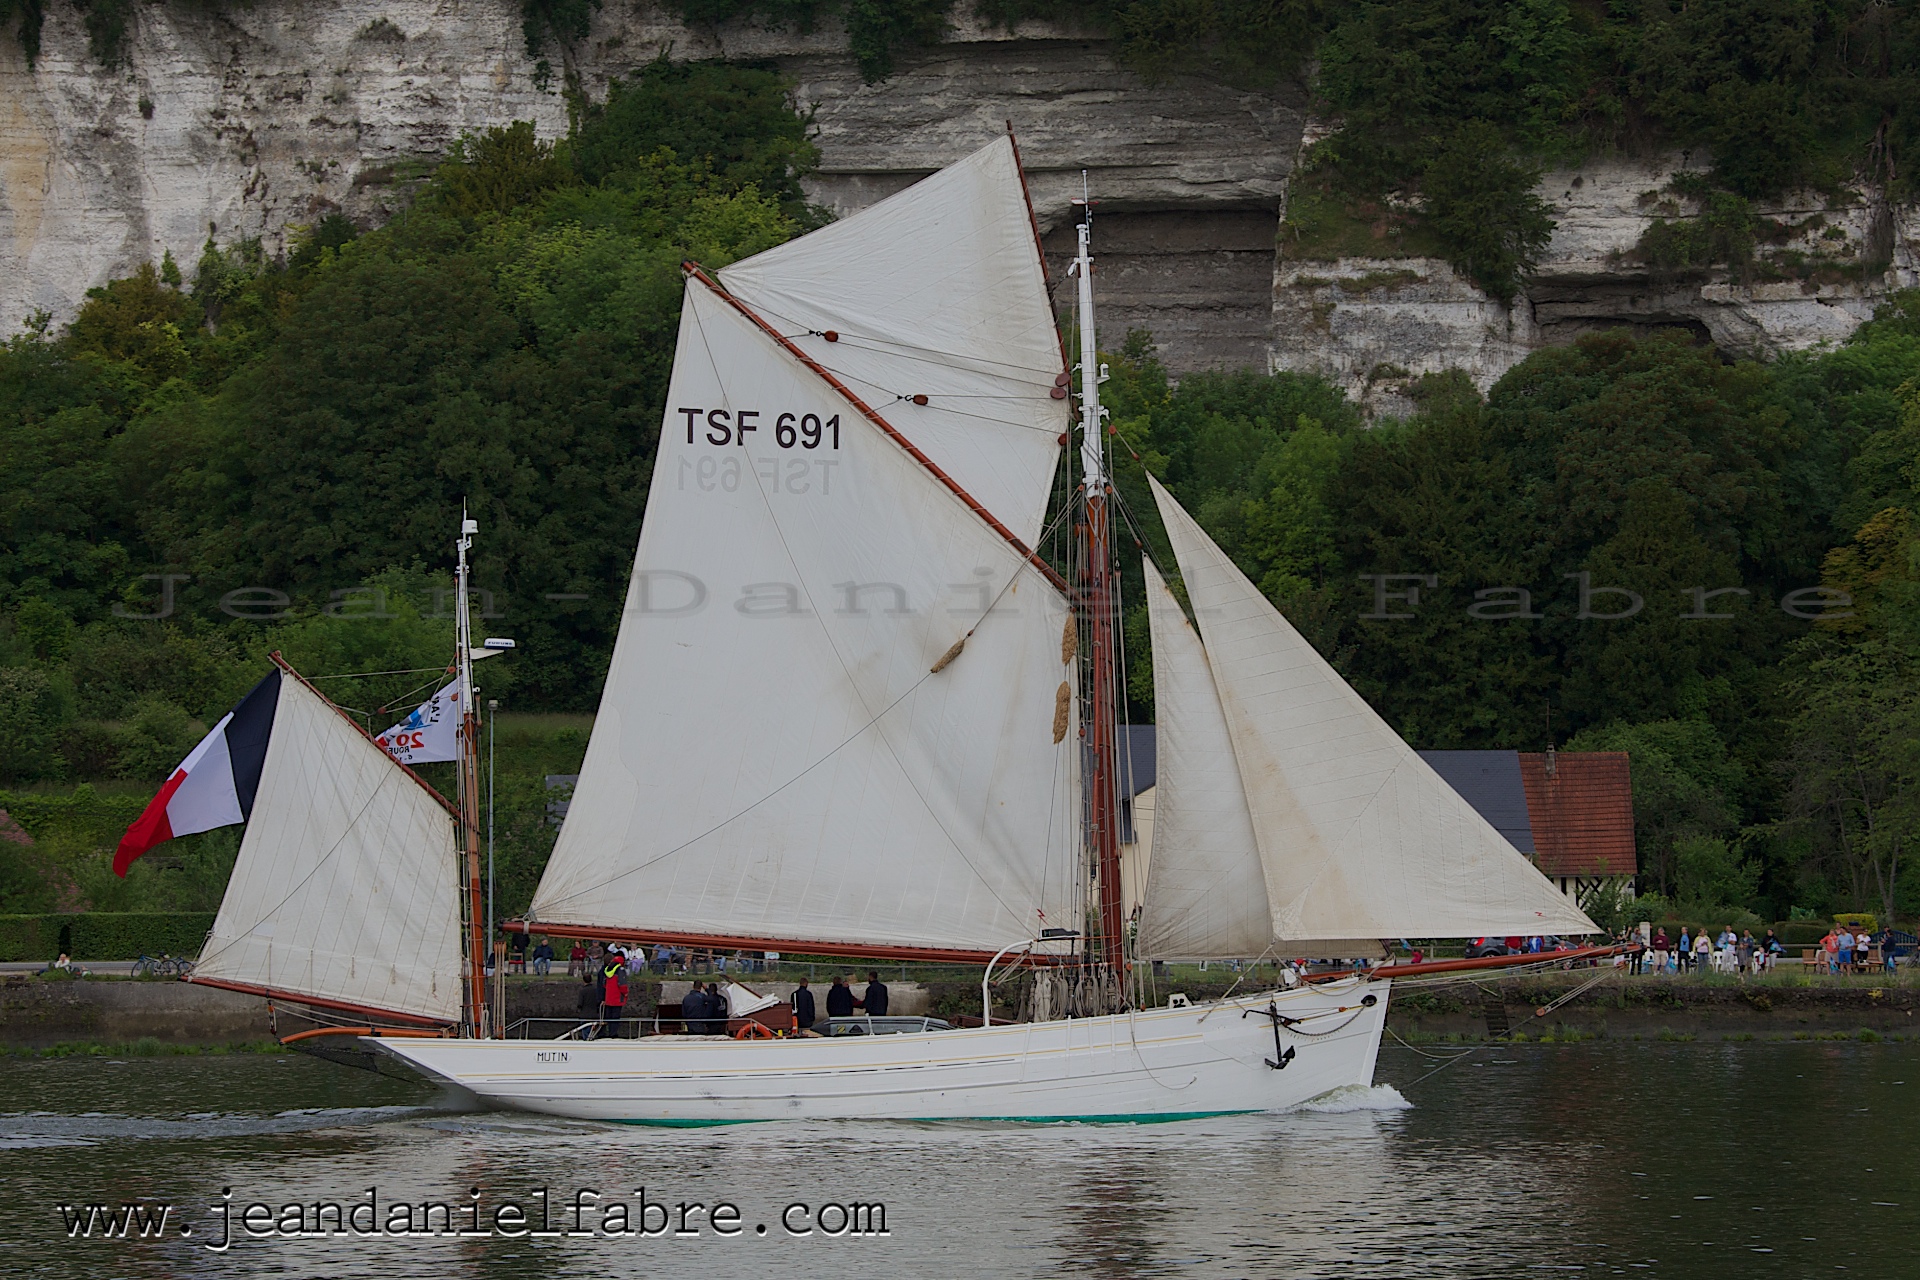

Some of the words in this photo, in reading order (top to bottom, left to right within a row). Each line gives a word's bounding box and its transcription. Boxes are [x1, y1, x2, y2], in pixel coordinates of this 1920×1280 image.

[678, 408, 760, 446] TSF
[775, 412, 840, 450] 691
[536, 1052, 568, 1062] MUTIN
